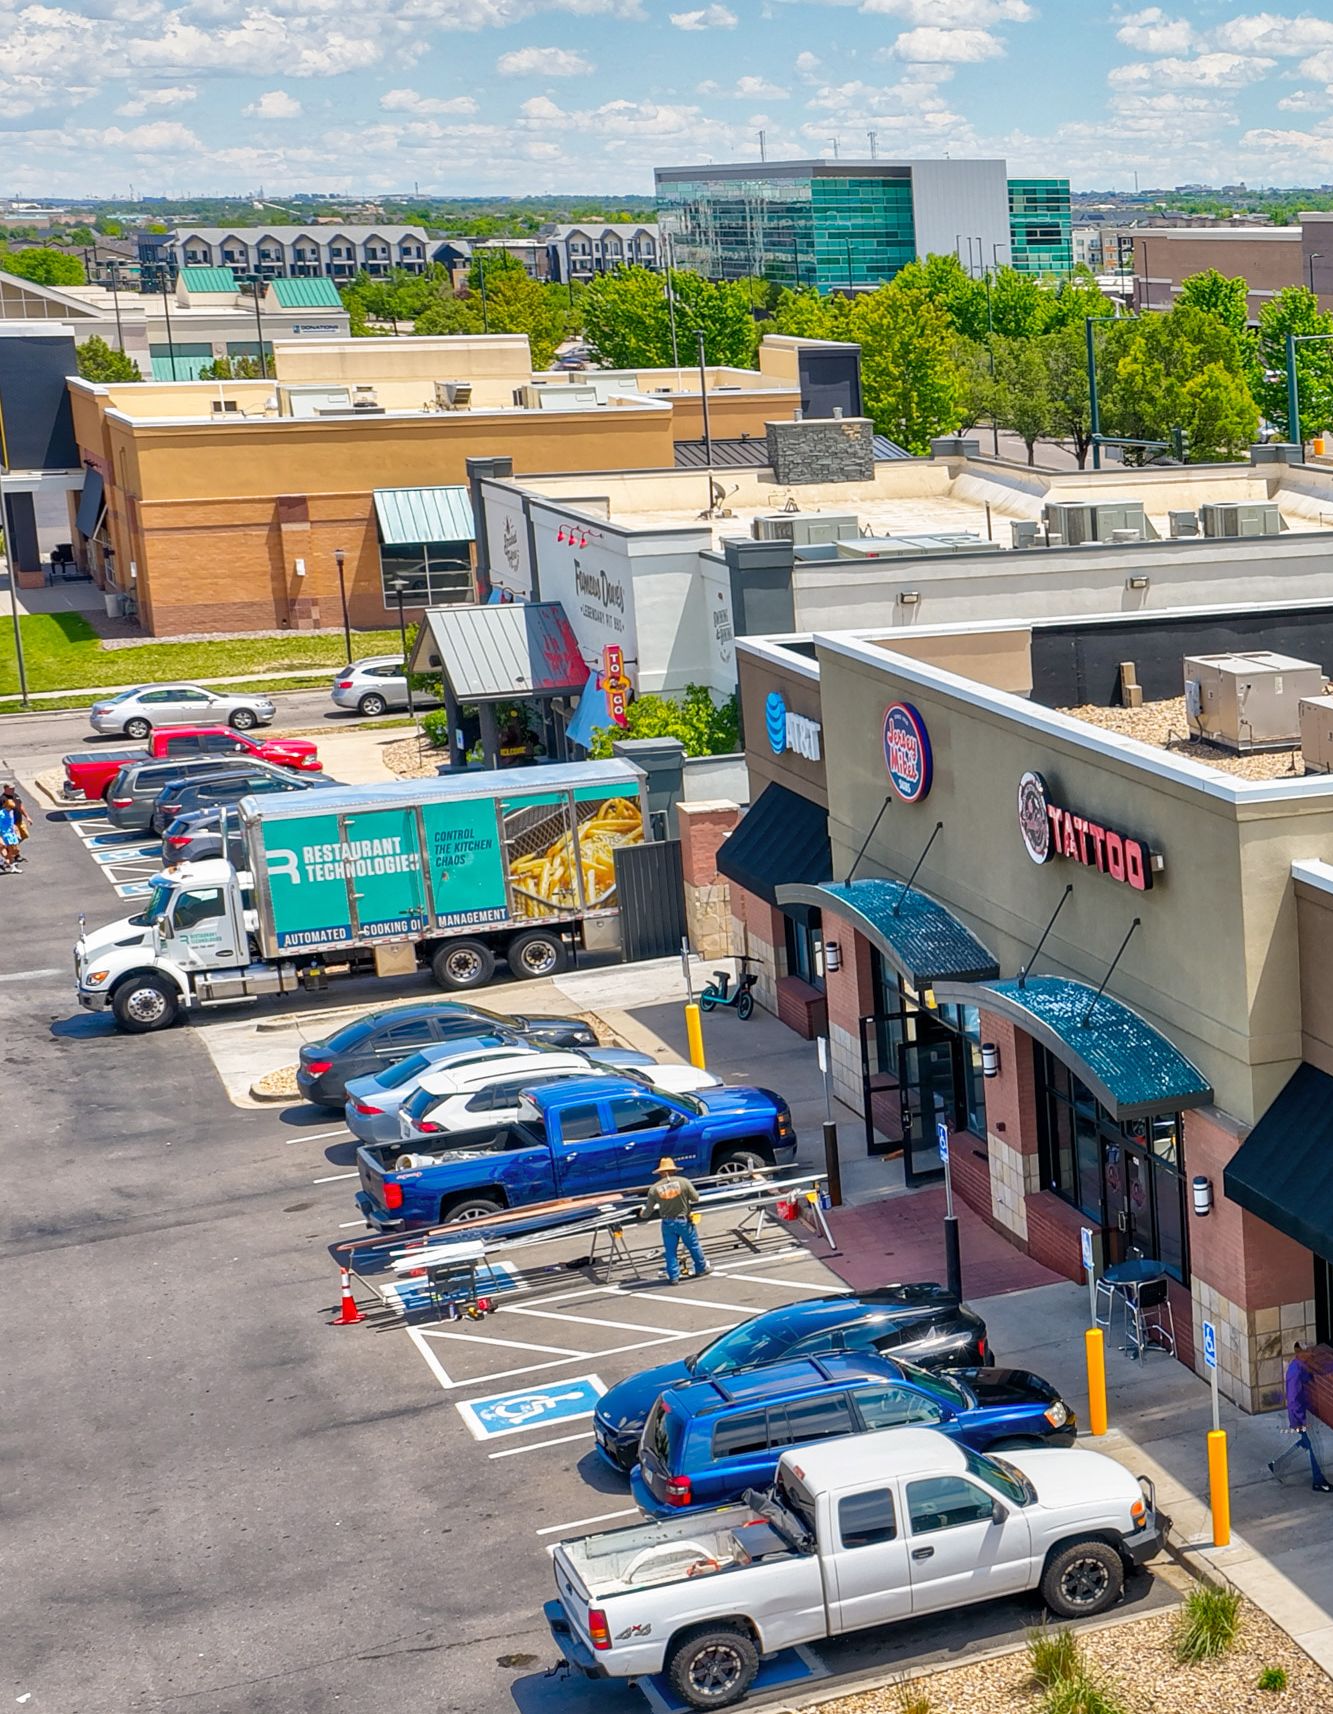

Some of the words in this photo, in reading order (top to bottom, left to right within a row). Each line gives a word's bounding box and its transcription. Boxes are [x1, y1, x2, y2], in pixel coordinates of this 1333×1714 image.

[574, 558, 600, 600] Famous
[600, 570, 624, 614] Dave's
[609, 654, 620, 672] TO
[613, 695, 624, 715] GO
[786, 712, 821, 761] AT&T
[887, 718, 917, 764] Jersey
[434, 828, 475, 842] CONTROL
[434, 843, 451, 855] THE
[454, 839, 493, 852] KITCHEN
[1047, 803, 1146, 891] TATTOO
[302, 837, 401, 864] RESTAURANT
[435, 854, 466, 868] CHAOS
[305, 853, 420, 882] TECHNOLOGIES
[285, 928, 346, 945] AUTOMATED
[363, 921, 408, 936] COOKING
[438, 908, 507, 927] MANAGEMENT
